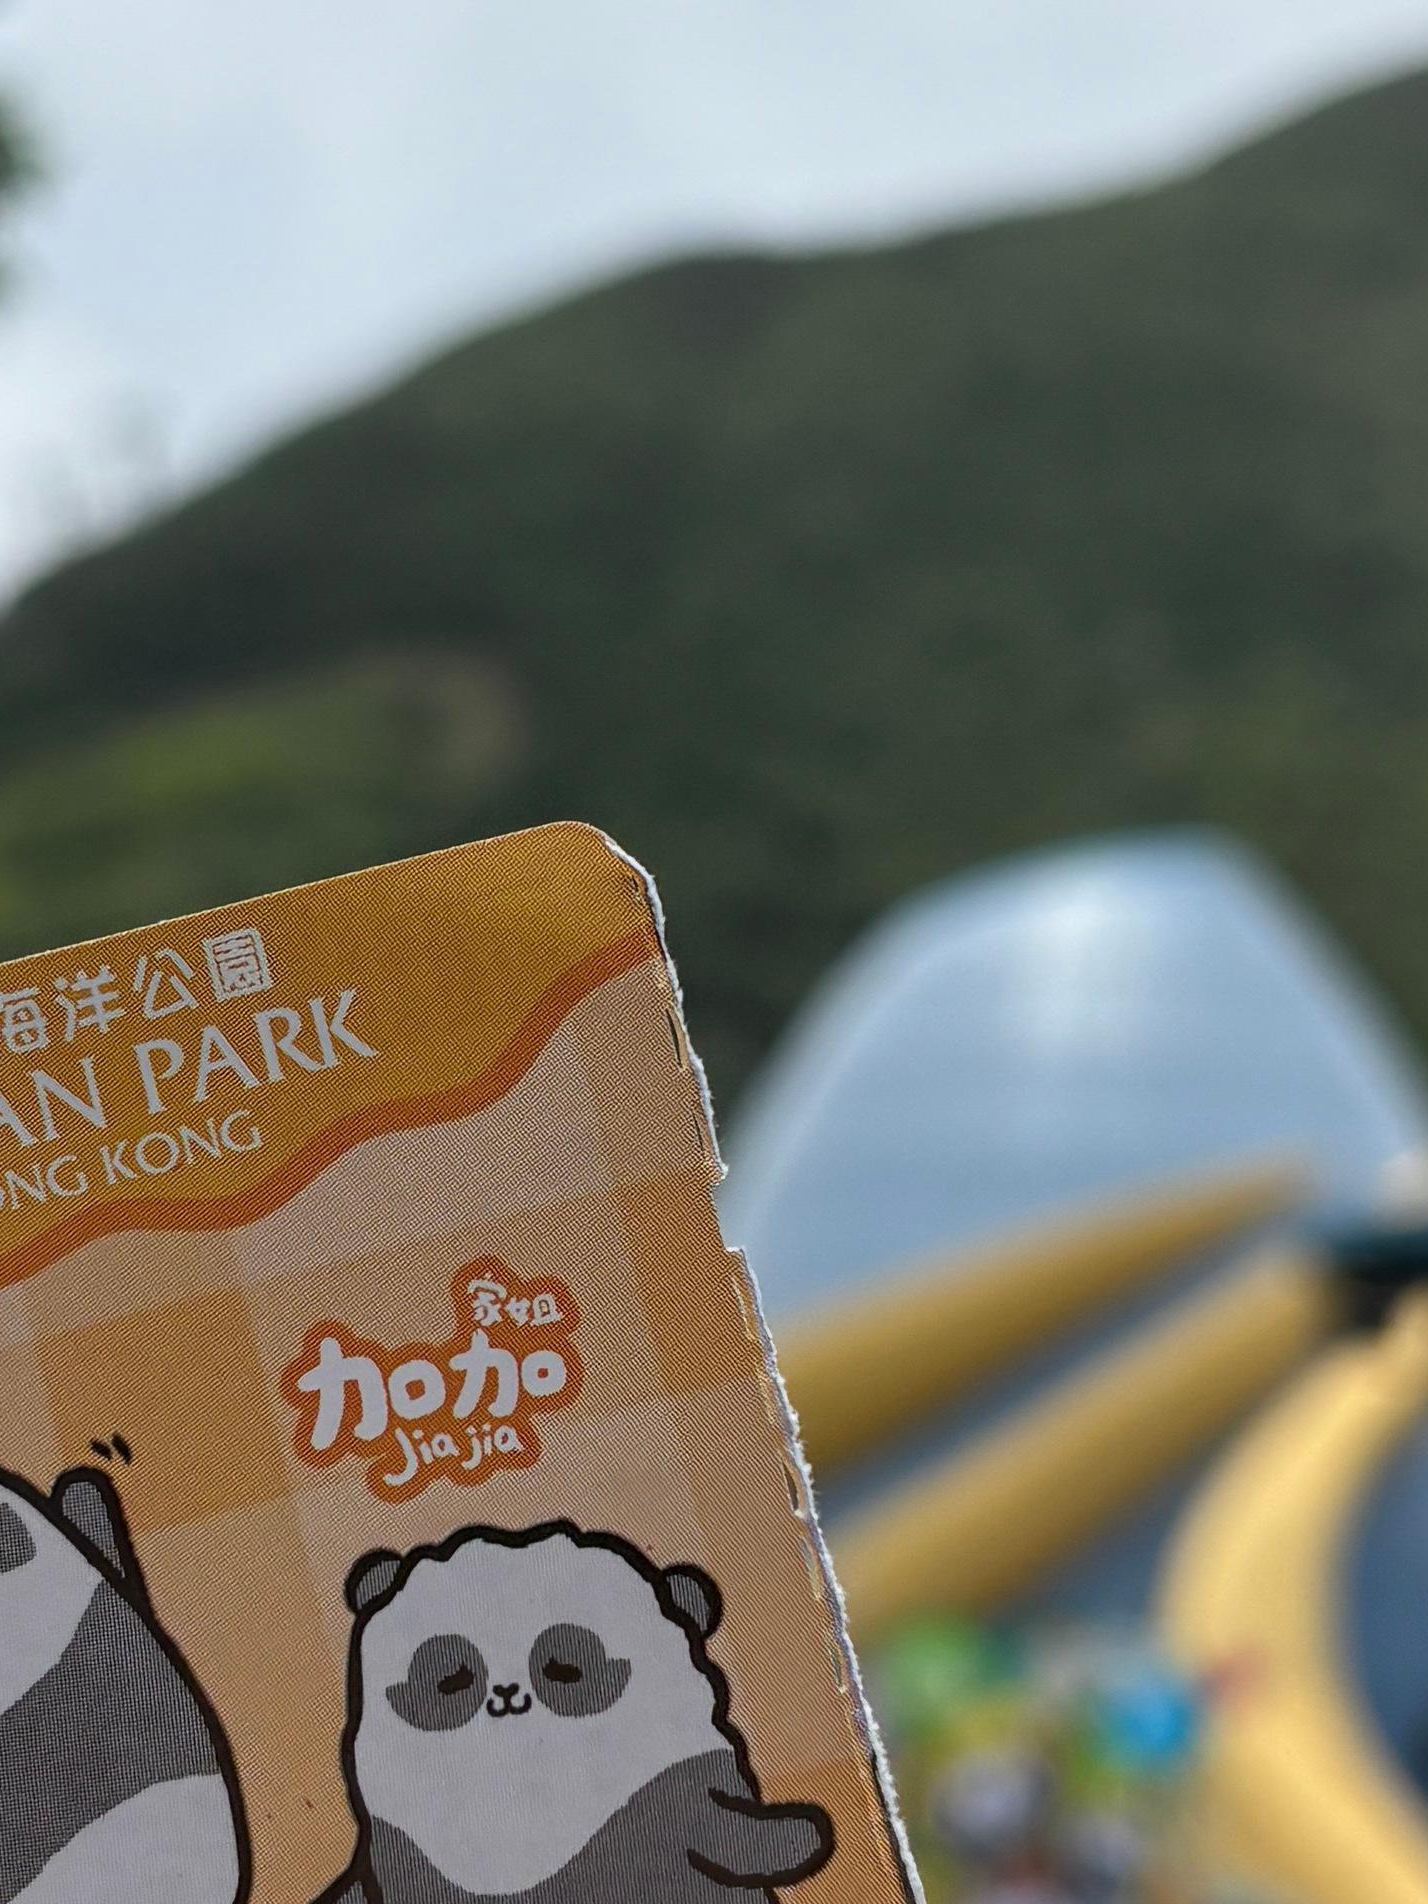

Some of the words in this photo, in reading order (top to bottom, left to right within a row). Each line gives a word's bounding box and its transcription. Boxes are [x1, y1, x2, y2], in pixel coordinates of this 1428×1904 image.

[133, 989, 378, 1115] PARK
[101, 1109, 264, 1187] KONG
[468, 1271, 562, 1326] 家姐
[297, 1328, 567, 1451] 加加
